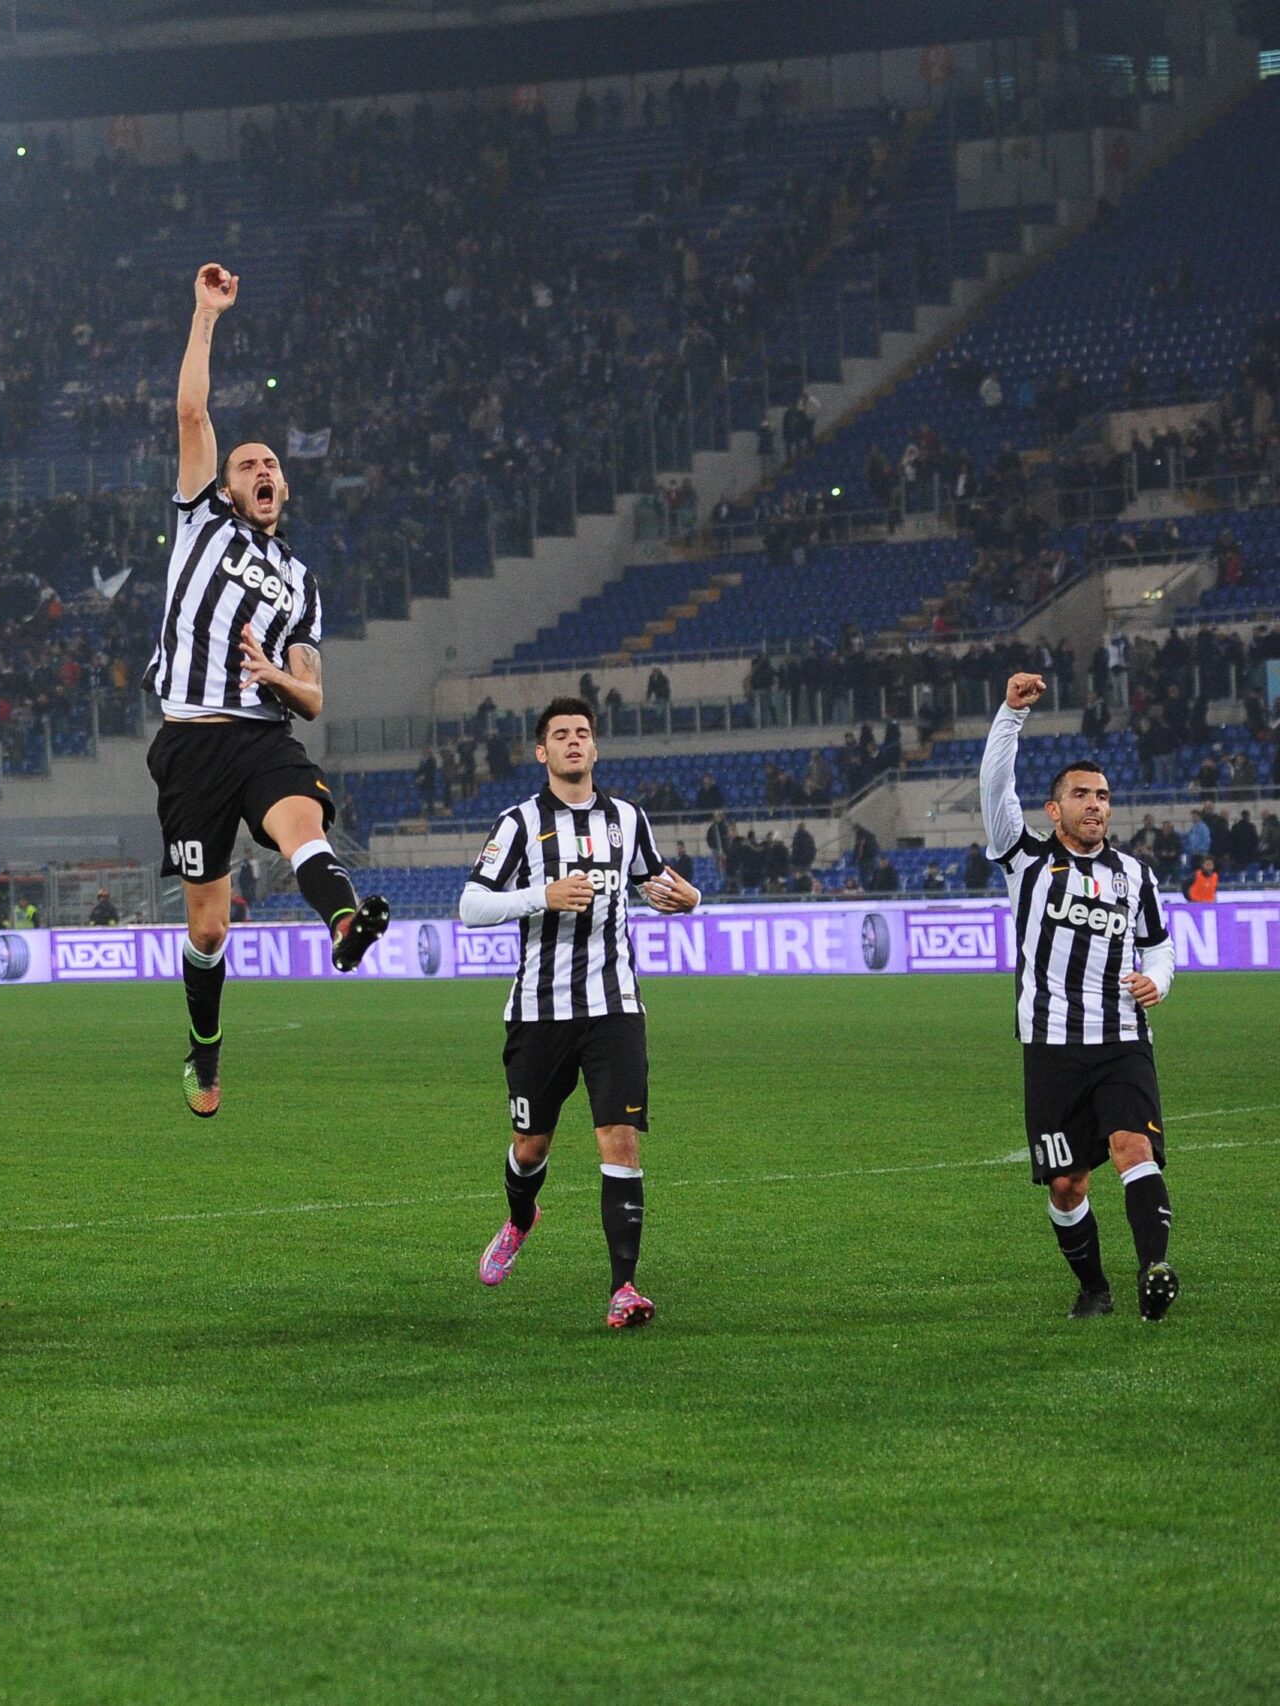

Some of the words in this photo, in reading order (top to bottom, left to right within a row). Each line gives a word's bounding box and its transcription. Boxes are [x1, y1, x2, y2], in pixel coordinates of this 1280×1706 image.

[223, 554, 292, 612] Jeep
[178, 840, 204, 877] 19
[1047, 894, 1127, 938] Jeep
[719, 920, 848, 972] TIRE
[910, 924, 996, 957] NEXEN
[1041, 1132, 1073, 1168] 10
